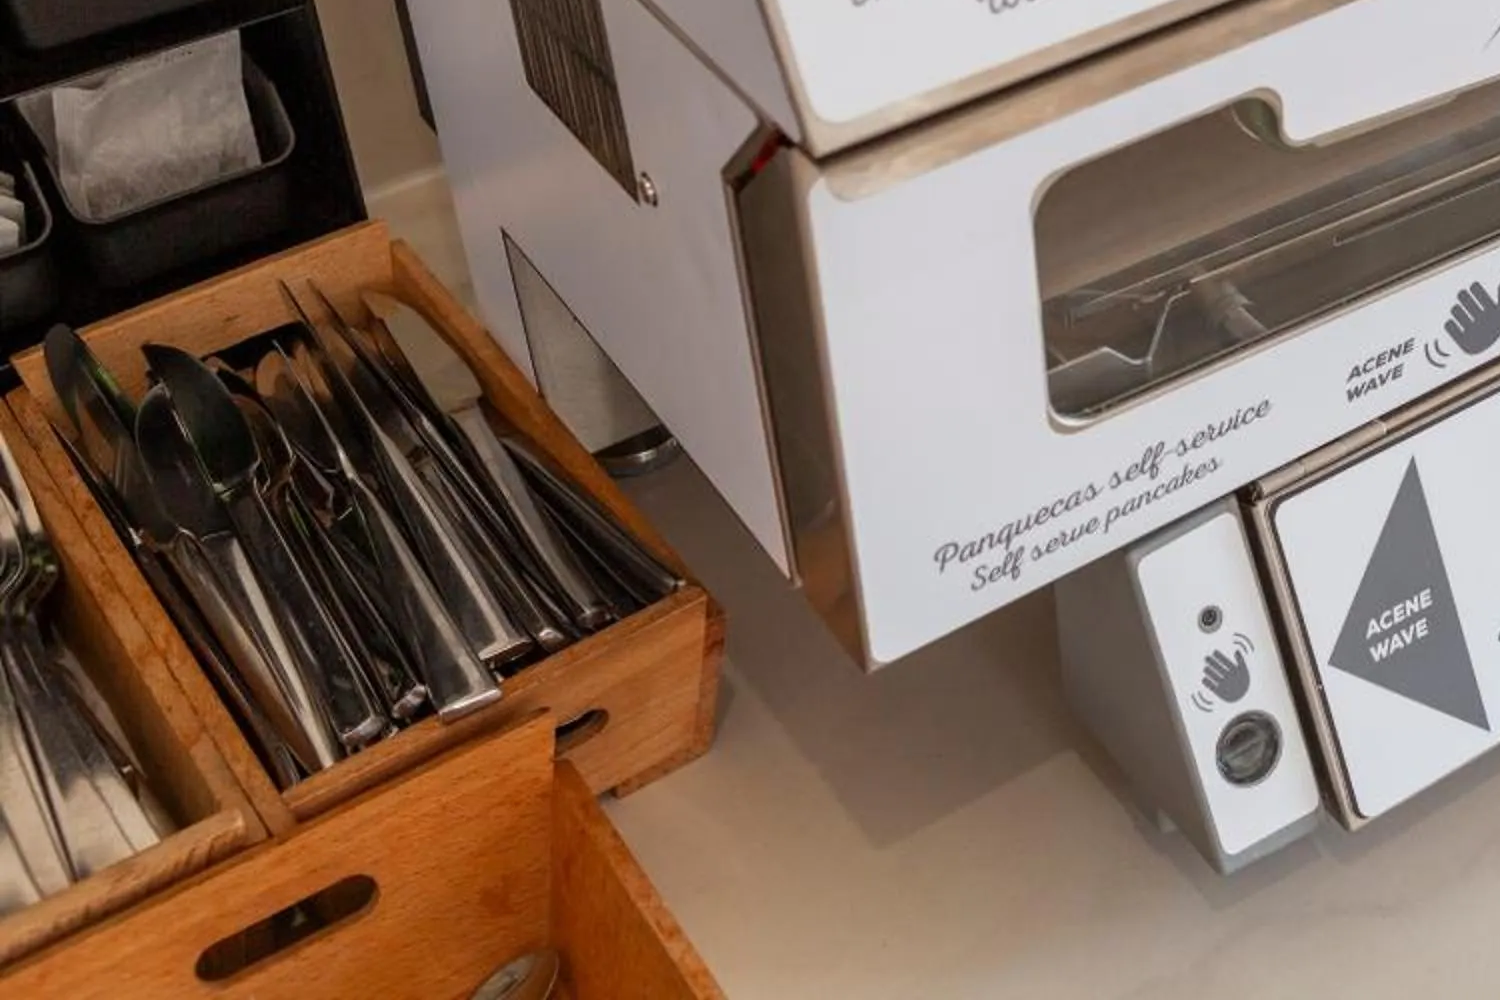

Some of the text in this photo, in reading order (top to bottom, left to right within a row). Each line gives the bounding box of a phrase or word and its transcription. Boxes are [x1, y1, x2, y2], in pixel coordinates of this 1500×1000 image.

[1345, 363, 1405, 404] WAVE
[1346, 337, 1416, 382] ACENE
[934, 396, 1274, 573] Panquecas self-service
[970, 455, 1224, 592] Self serve pancakes
[1365, 587, 1433, 640] ACENE
[1368, 617, 1430, 664] WAVE
